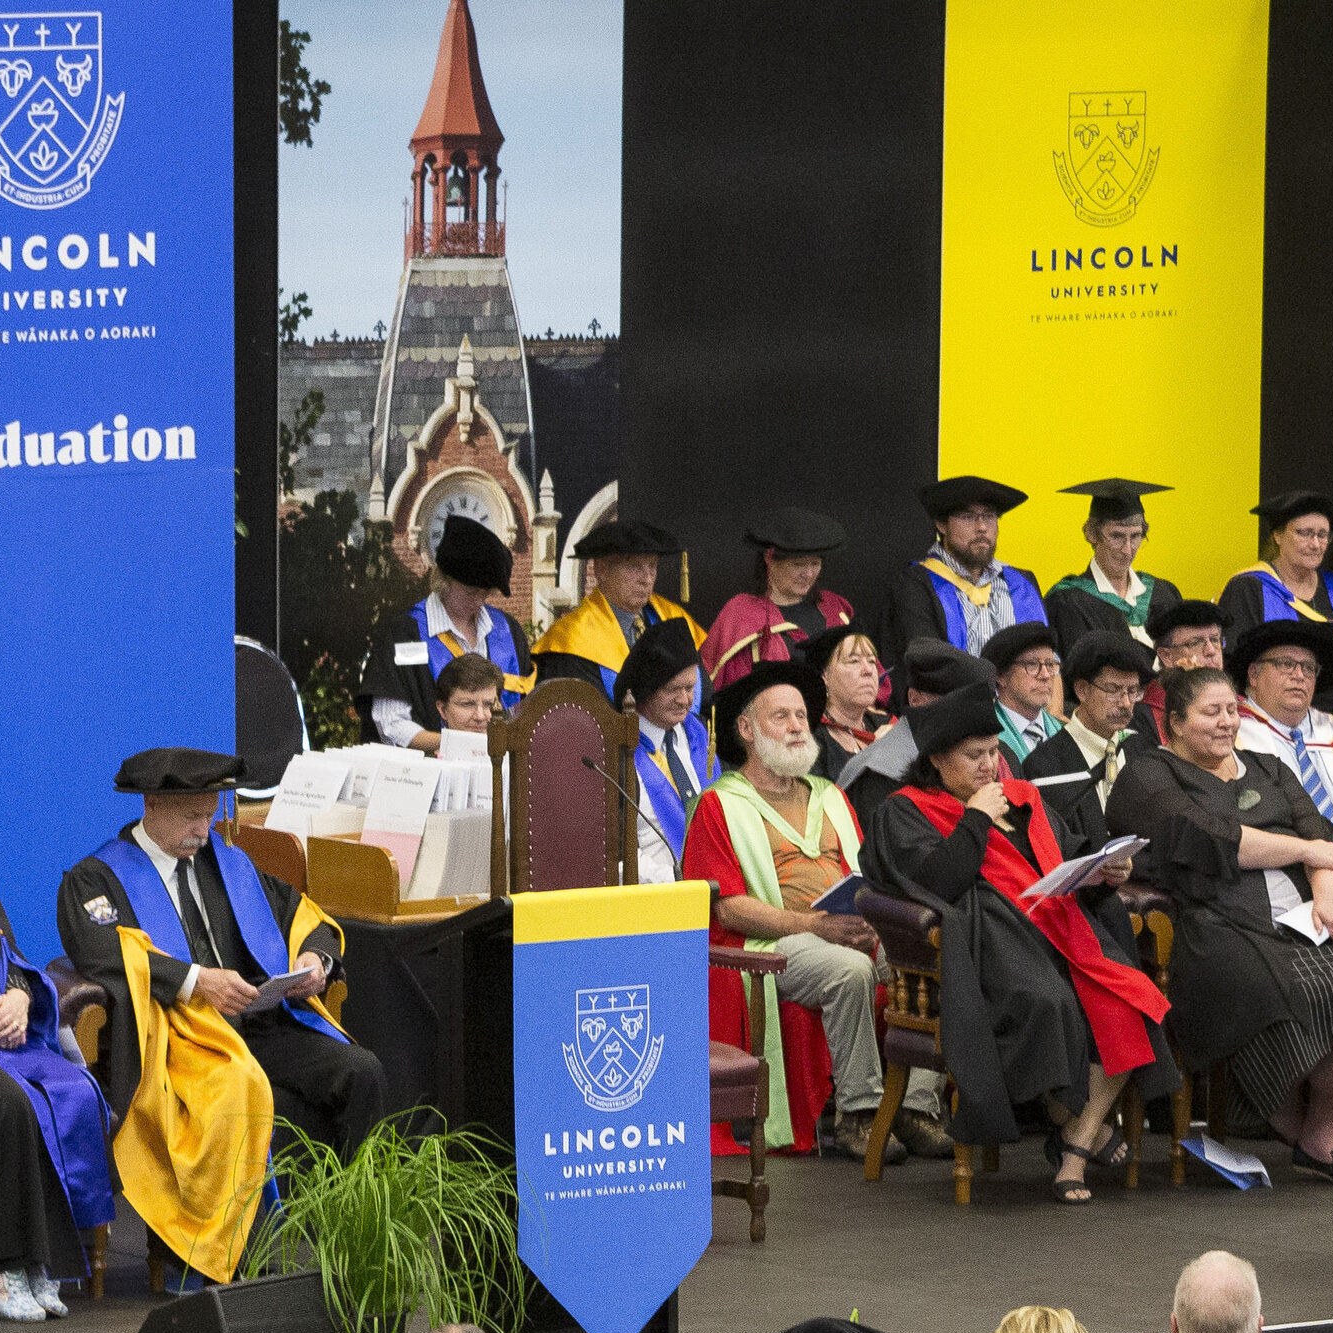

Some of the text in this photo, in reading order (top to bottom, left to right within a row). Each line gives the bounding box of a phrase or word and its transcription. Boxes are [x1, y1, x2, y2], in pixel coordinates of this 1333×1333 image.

[89, 109, 117, 163] PROBITATE
[1031, 244, 1179, 272] LINCOLN
[1050, 283, 1160, 299] UNIVERSITY
[84, 327, 96, 341] O
[100, 325, 157, 340] AORAKI
[544, 1121, 686, 1156] LINCOLN
[563, 1157, 667, 1179] UNIVERSITY
[544, 1192, 556, 1201] TE
[558, 1188, 593, 1200] WHARE
[638, 1183, 646, 1193] O
[648, 1180, 686, 1193] AORAKI
